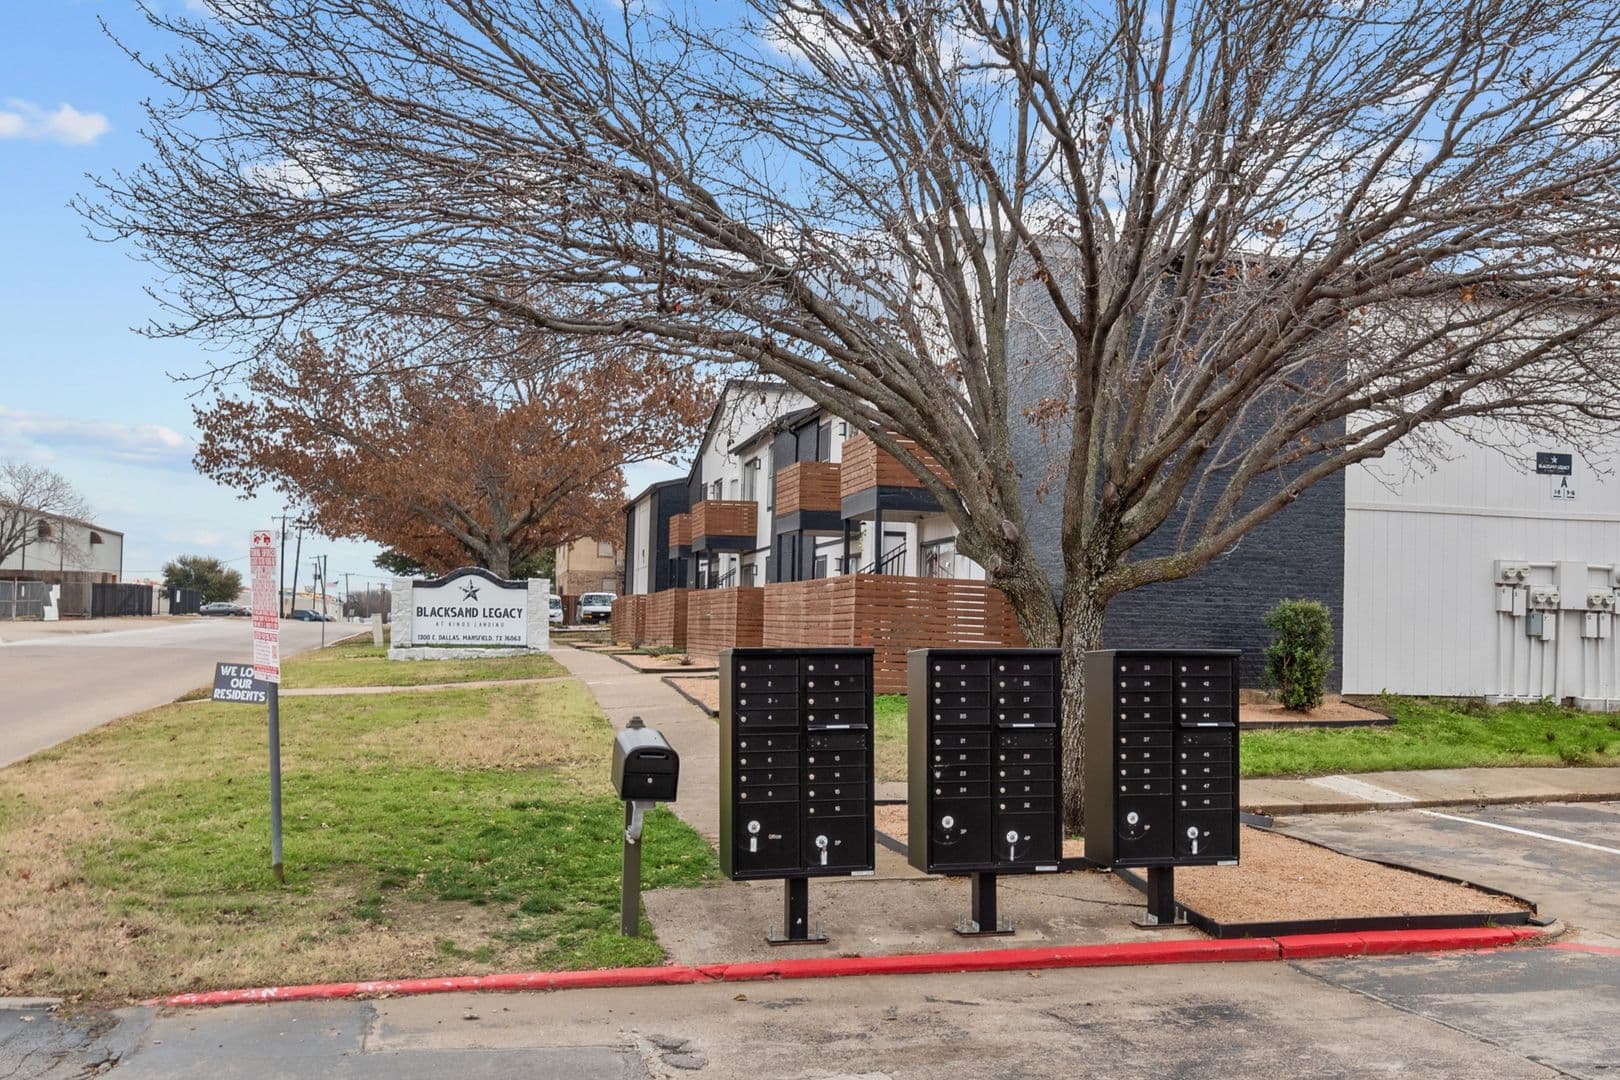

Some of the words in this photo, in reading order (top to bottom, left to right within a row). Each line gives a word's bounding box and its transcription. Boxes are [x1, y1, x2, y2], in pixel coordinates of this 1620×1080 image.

[1560, 476, 1568, 488] A
[416, 606, 478, 618] BLACKSAND
[483, 607, 523, 619] LEGACY
[220, 665, 238, 676] WE
[240, 667, 254, 678] LO
[230, 678, 253, 689] OUR
[213, 688, 266, 702] RESIDENTS
